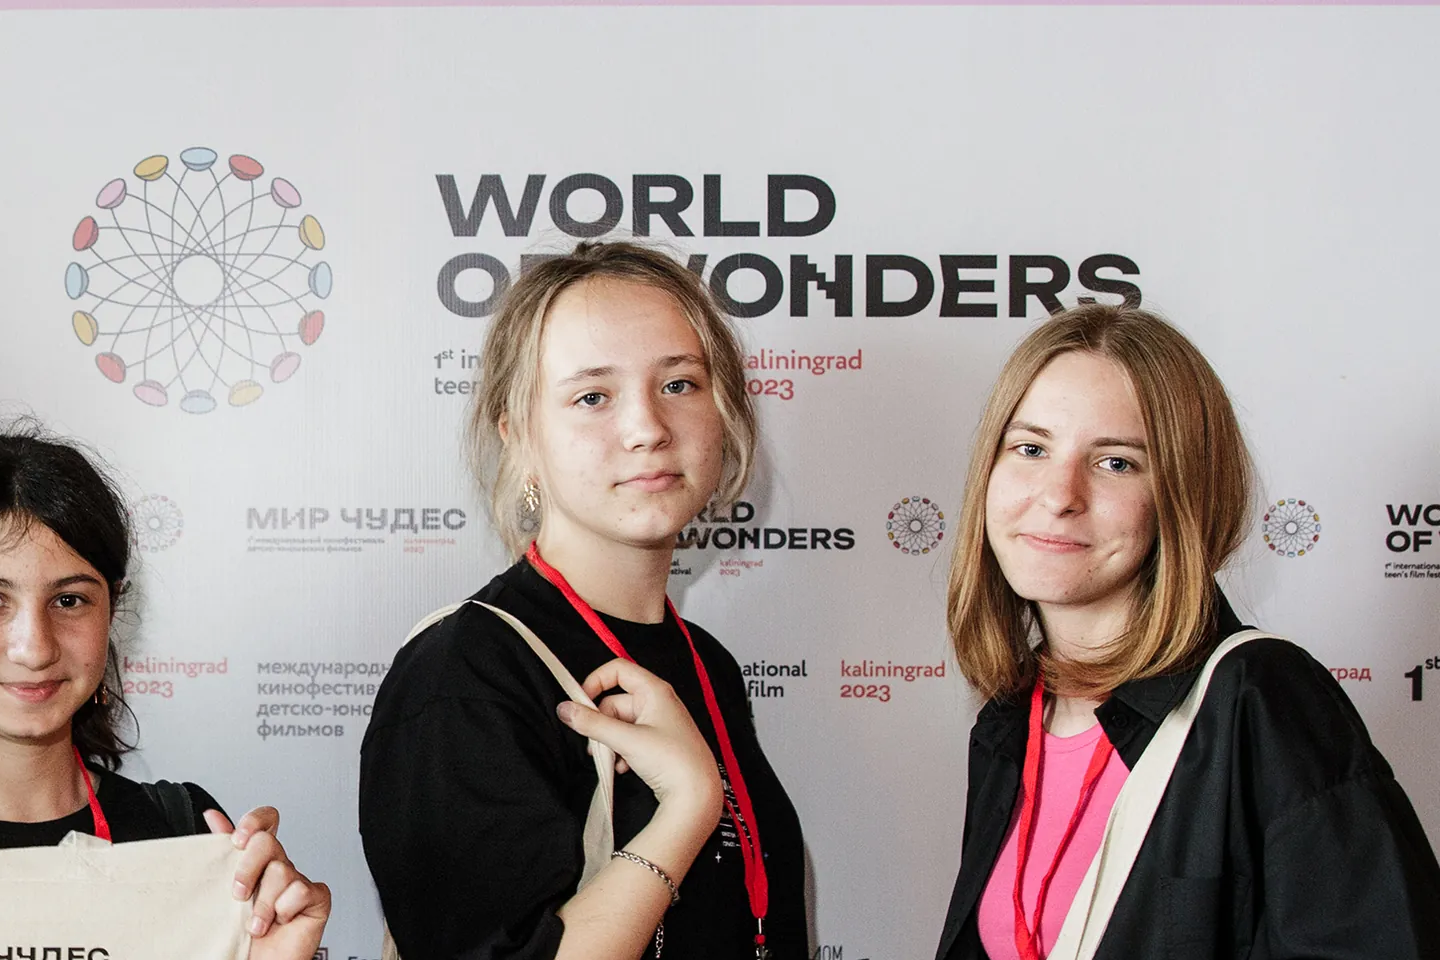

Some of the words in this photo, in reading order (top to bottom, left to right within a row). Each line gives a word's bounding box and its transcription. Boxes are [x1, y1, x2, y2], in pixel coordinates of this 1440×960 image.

[434, 173, 837, 238] WORLD
[694, 253, 1143, 318] ONDERS
[433, 348, 455, 369] 1st
[747, 349, 863, 375] aliningrad
[747, 378, 795, 400] 023
[246, 507, 330, 530] МИР
[340, 507, 467, 534] ЧУДЕС
[1385, 530, 1433, 552] OF
[1393, 561, 1440, 570] internationa
[123, 656, 229, 678] kaliningrad
[840, 660, 946, 682] kaliningrad
[123, 681, 174, 699] 2023
[747, 680, 784, 699] film
[840, 684, 891, 702] 2023
[256, 719, 345, 741] фильмов
